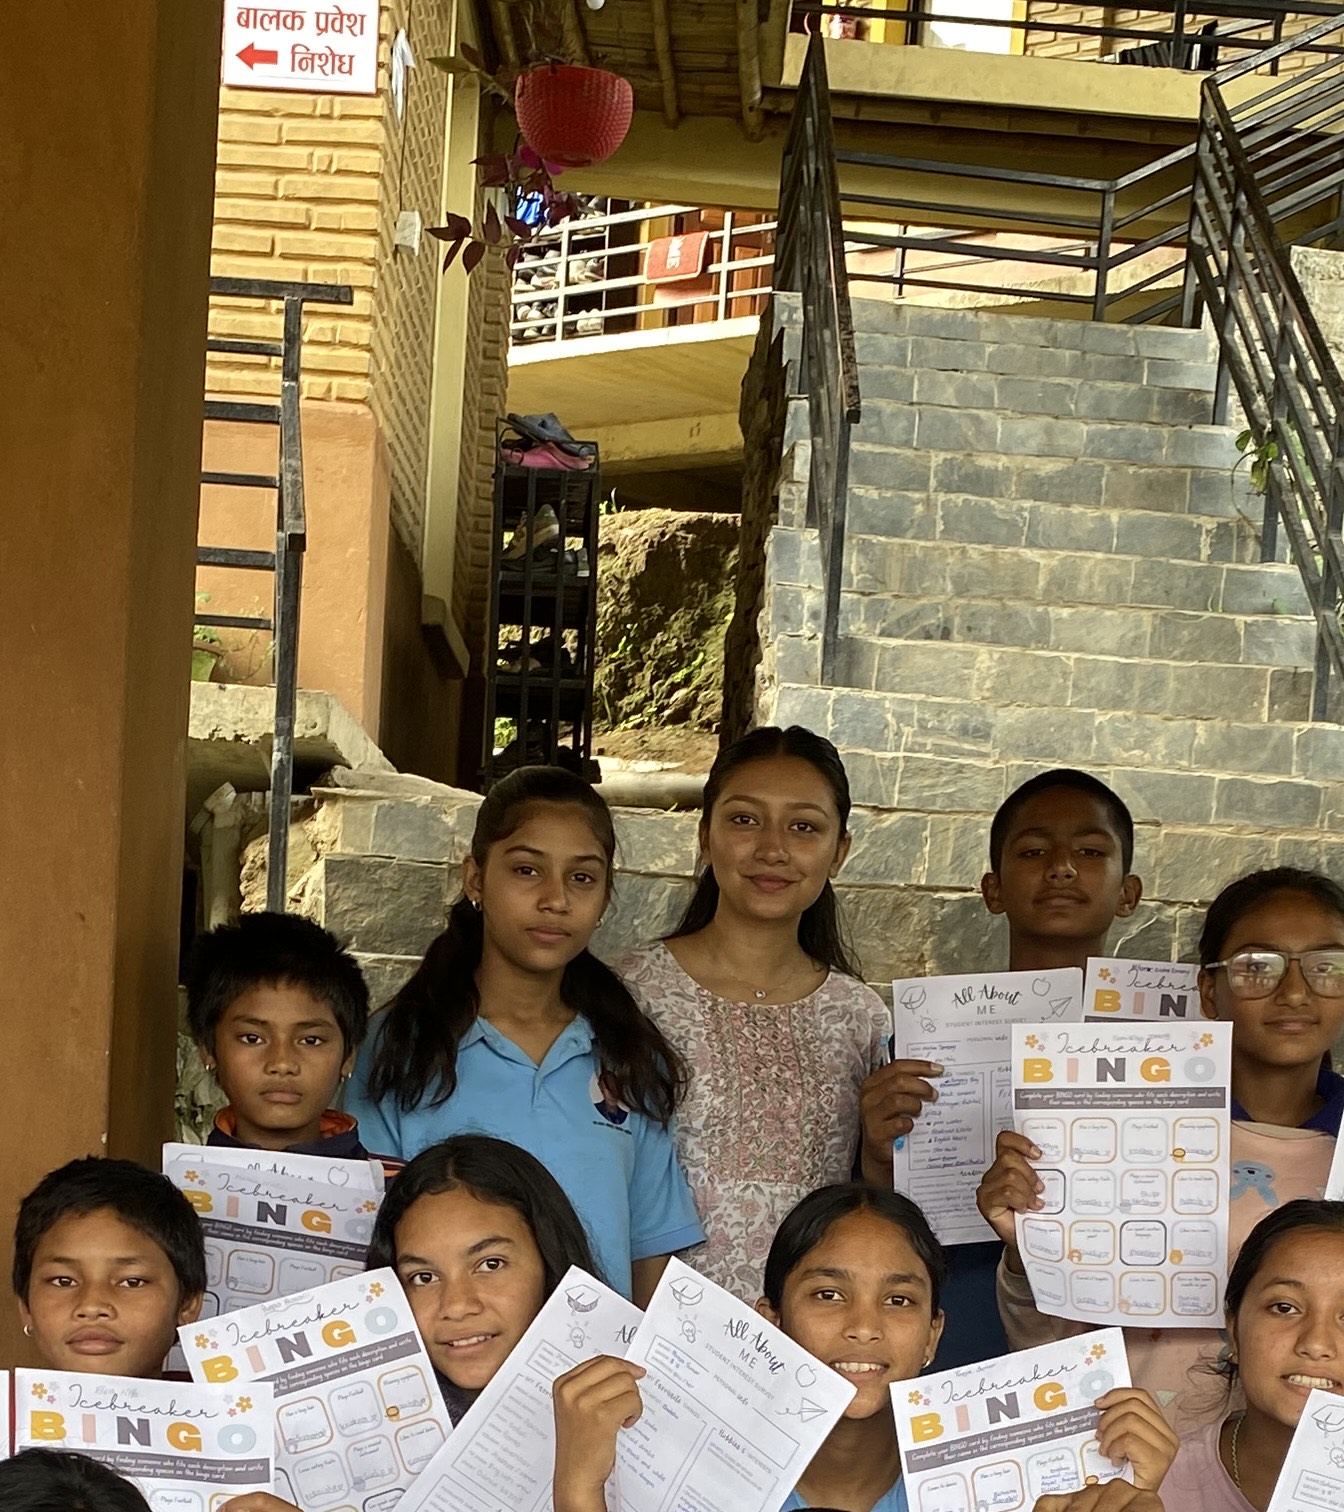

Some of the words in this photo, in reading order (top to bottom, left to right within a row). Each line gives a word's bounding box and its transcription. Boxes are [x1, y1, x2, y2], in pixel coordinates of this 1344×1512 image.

[237, 7, 306, 31] बालक
[315, 5, 367, 36] प्रवेश
[952, 988, 975, 1009] All
[978, 984, 1023, 1006] About
[1126, 967, 1200, 991] Icebrea
[976, 1004, 997, 1015] ME
[1093, 989, 1204, 1017] BIN
[1057, 1032, 1186, 1054] Icebreaker
[1023, 1057, 1216, 1083] BINGO
[217, 1172, 348, 1212] Icebreaker
[183, 1188, 375, 1242] BINGO
[226, 1302, 360, 1346] Icebreaker
[201, 1306, 398, 1384] BINGO
[723, 1318, 749, 1341] All
[749, 1331, 787, 1376] About
[738, 1348, 758, 1369] ME
[68, 1382, 220, 1420] Icebreaker
[941, 1363, 1078, 1405] Icebreaker
[909, 1369, 1115, 1444] BINGO
[30, 1410, 257, 1454] BINGO
